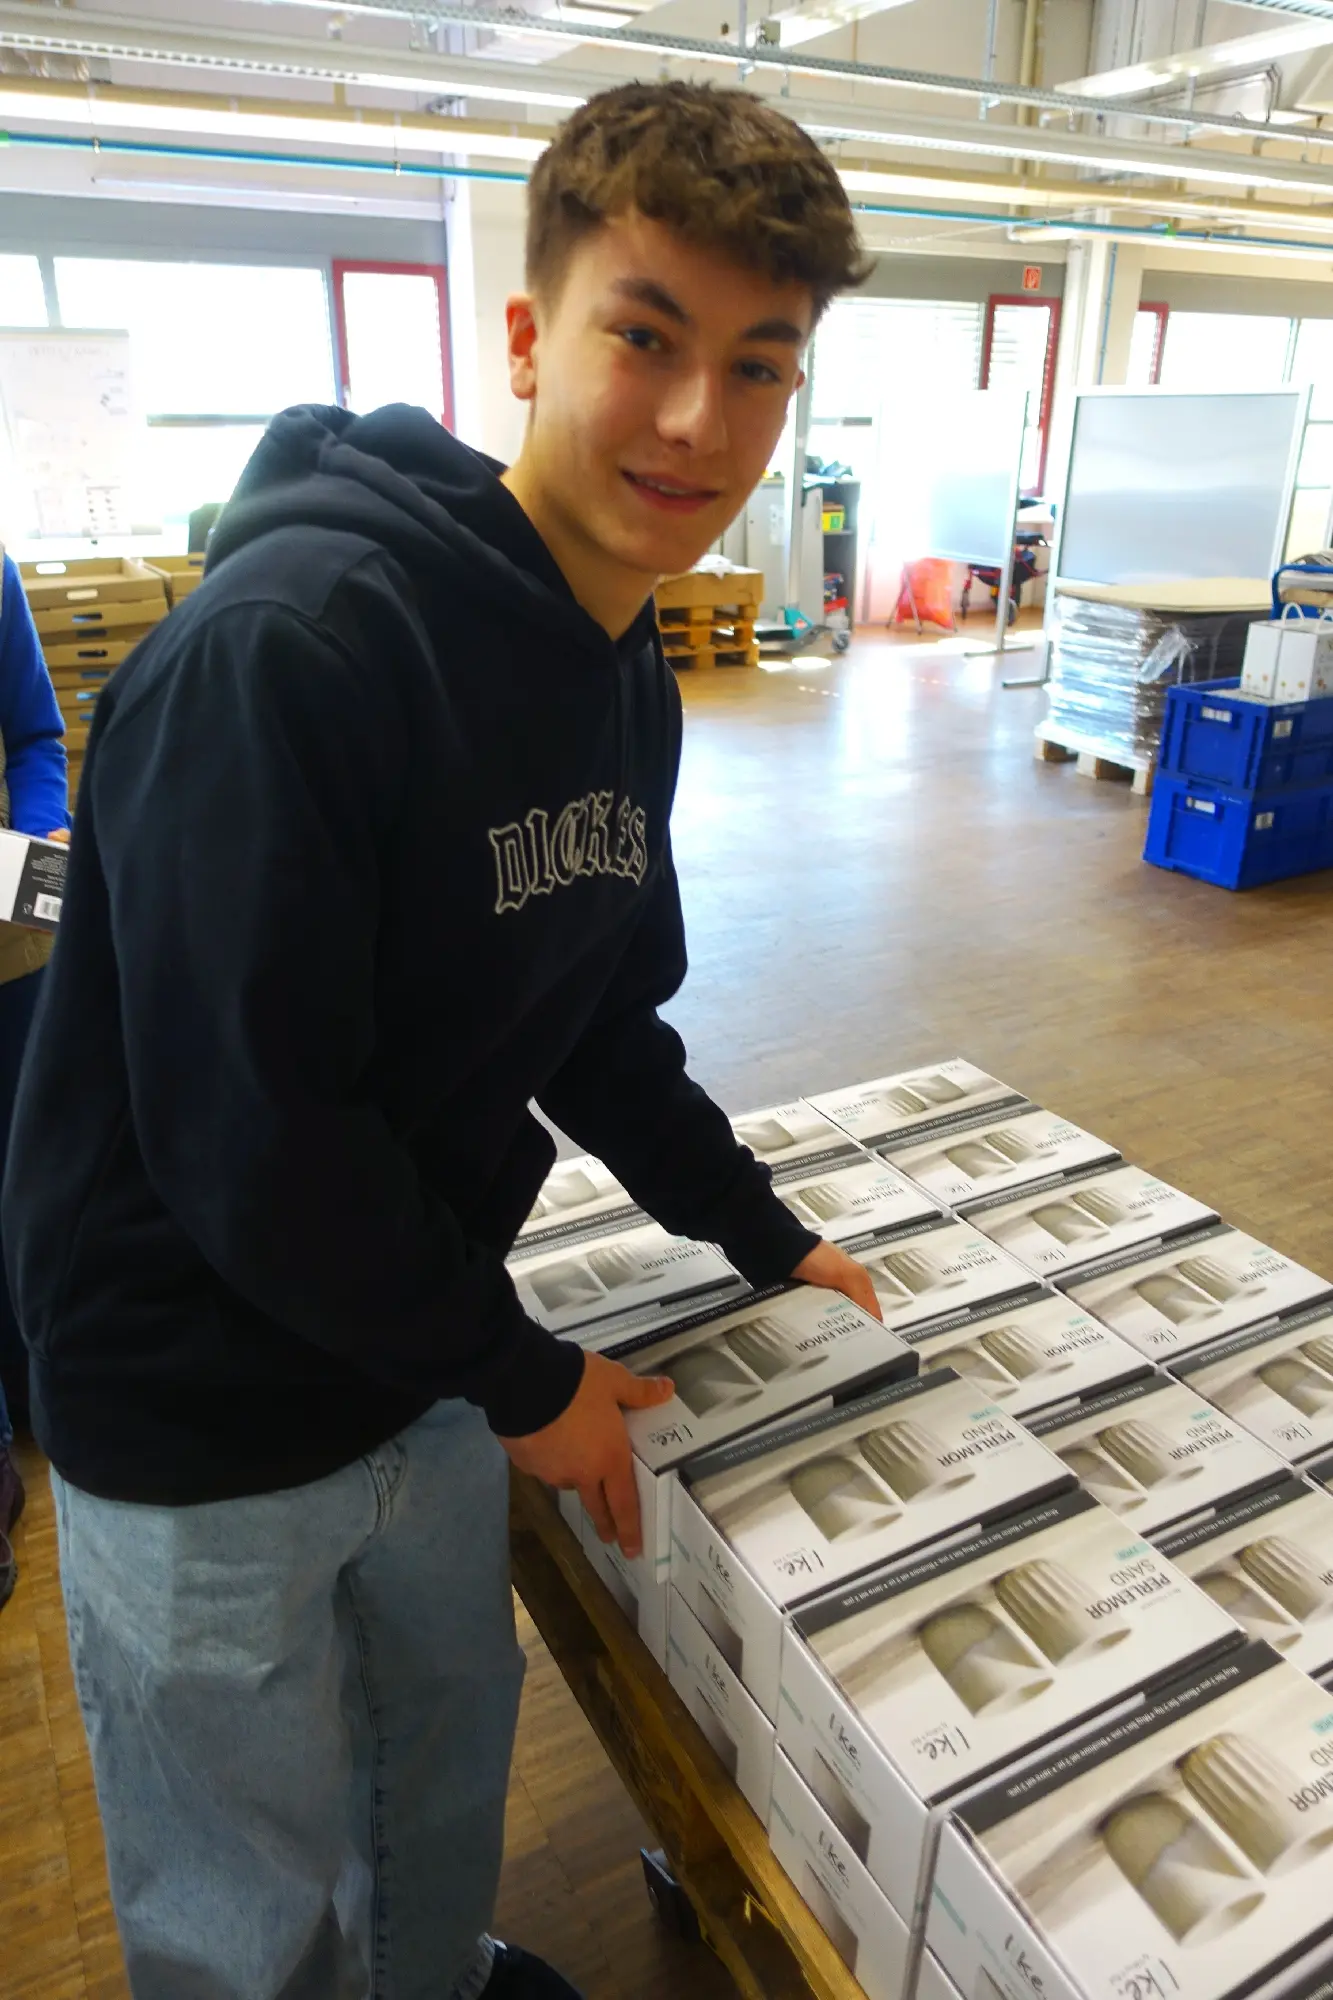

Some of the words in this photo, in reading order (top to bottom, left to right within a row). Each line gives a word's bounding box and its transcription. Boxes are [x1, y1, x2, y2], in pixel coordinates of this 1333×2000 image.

[641, 1248, 704, 1272] PERLEMOR
[940, 1254, 998, 1276] PERLEMOR
[794, 1318, 866, 1353] PERLEMOR
[1043, 1332, 1105, 1359] PERLEMOR
[961, 1418, 1005, 1442] SAND
[1185, 1418, 1223, 1439] SAND
[936, 1428, 1017, 1469] PERLEMOR
[1168, 1428, 1235, 1461] PERLEMOR
[1109, 1558, 1157, 1587] SAND
[1084, 1571, 1172, 1621] PERLEMOR
[916, 1726, 971, 1761] lke.
